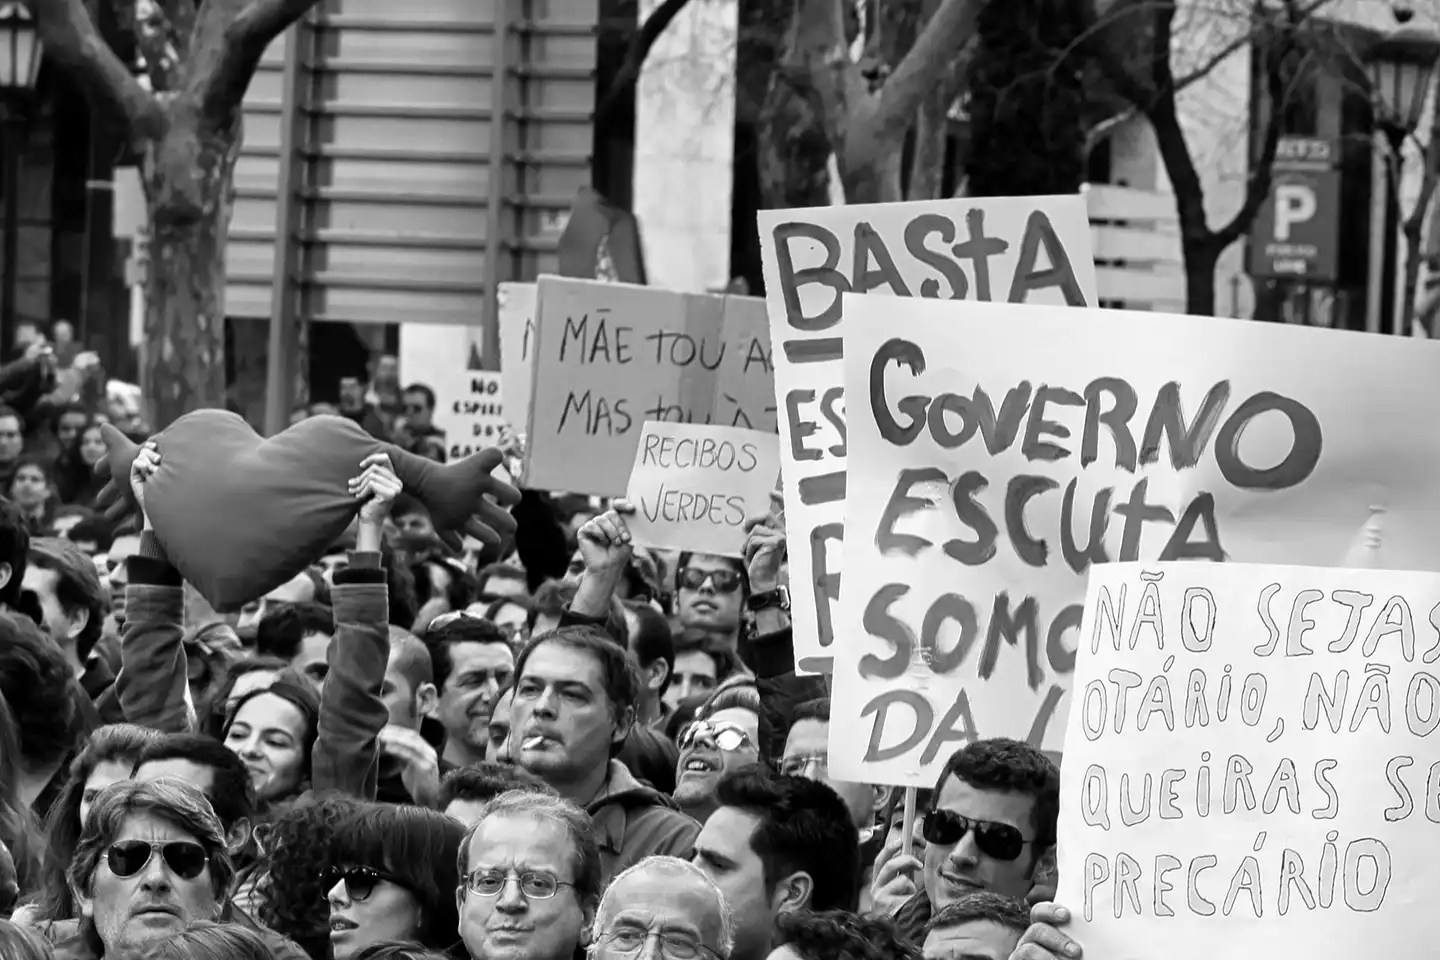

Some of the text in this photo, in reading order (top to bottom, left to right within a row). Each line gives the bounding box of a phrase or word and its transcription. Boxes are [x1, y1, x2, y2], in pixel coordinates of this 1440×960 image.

[1274, 185, 1317, 241] P
[558, 309, 633, 364] MÃE
[646, 328, 726, 371] TOU
[557, 389, 632, 436] MAS
[870, 338, 1323, 493] GOVERNO
[643, 434, 757, 471] RECIBOS
[641, 483, 745, 526] VERDES
[1091, 570, 1217, 655] NÃO
[1084, 831, 1391, 922] PRECÁRIO
